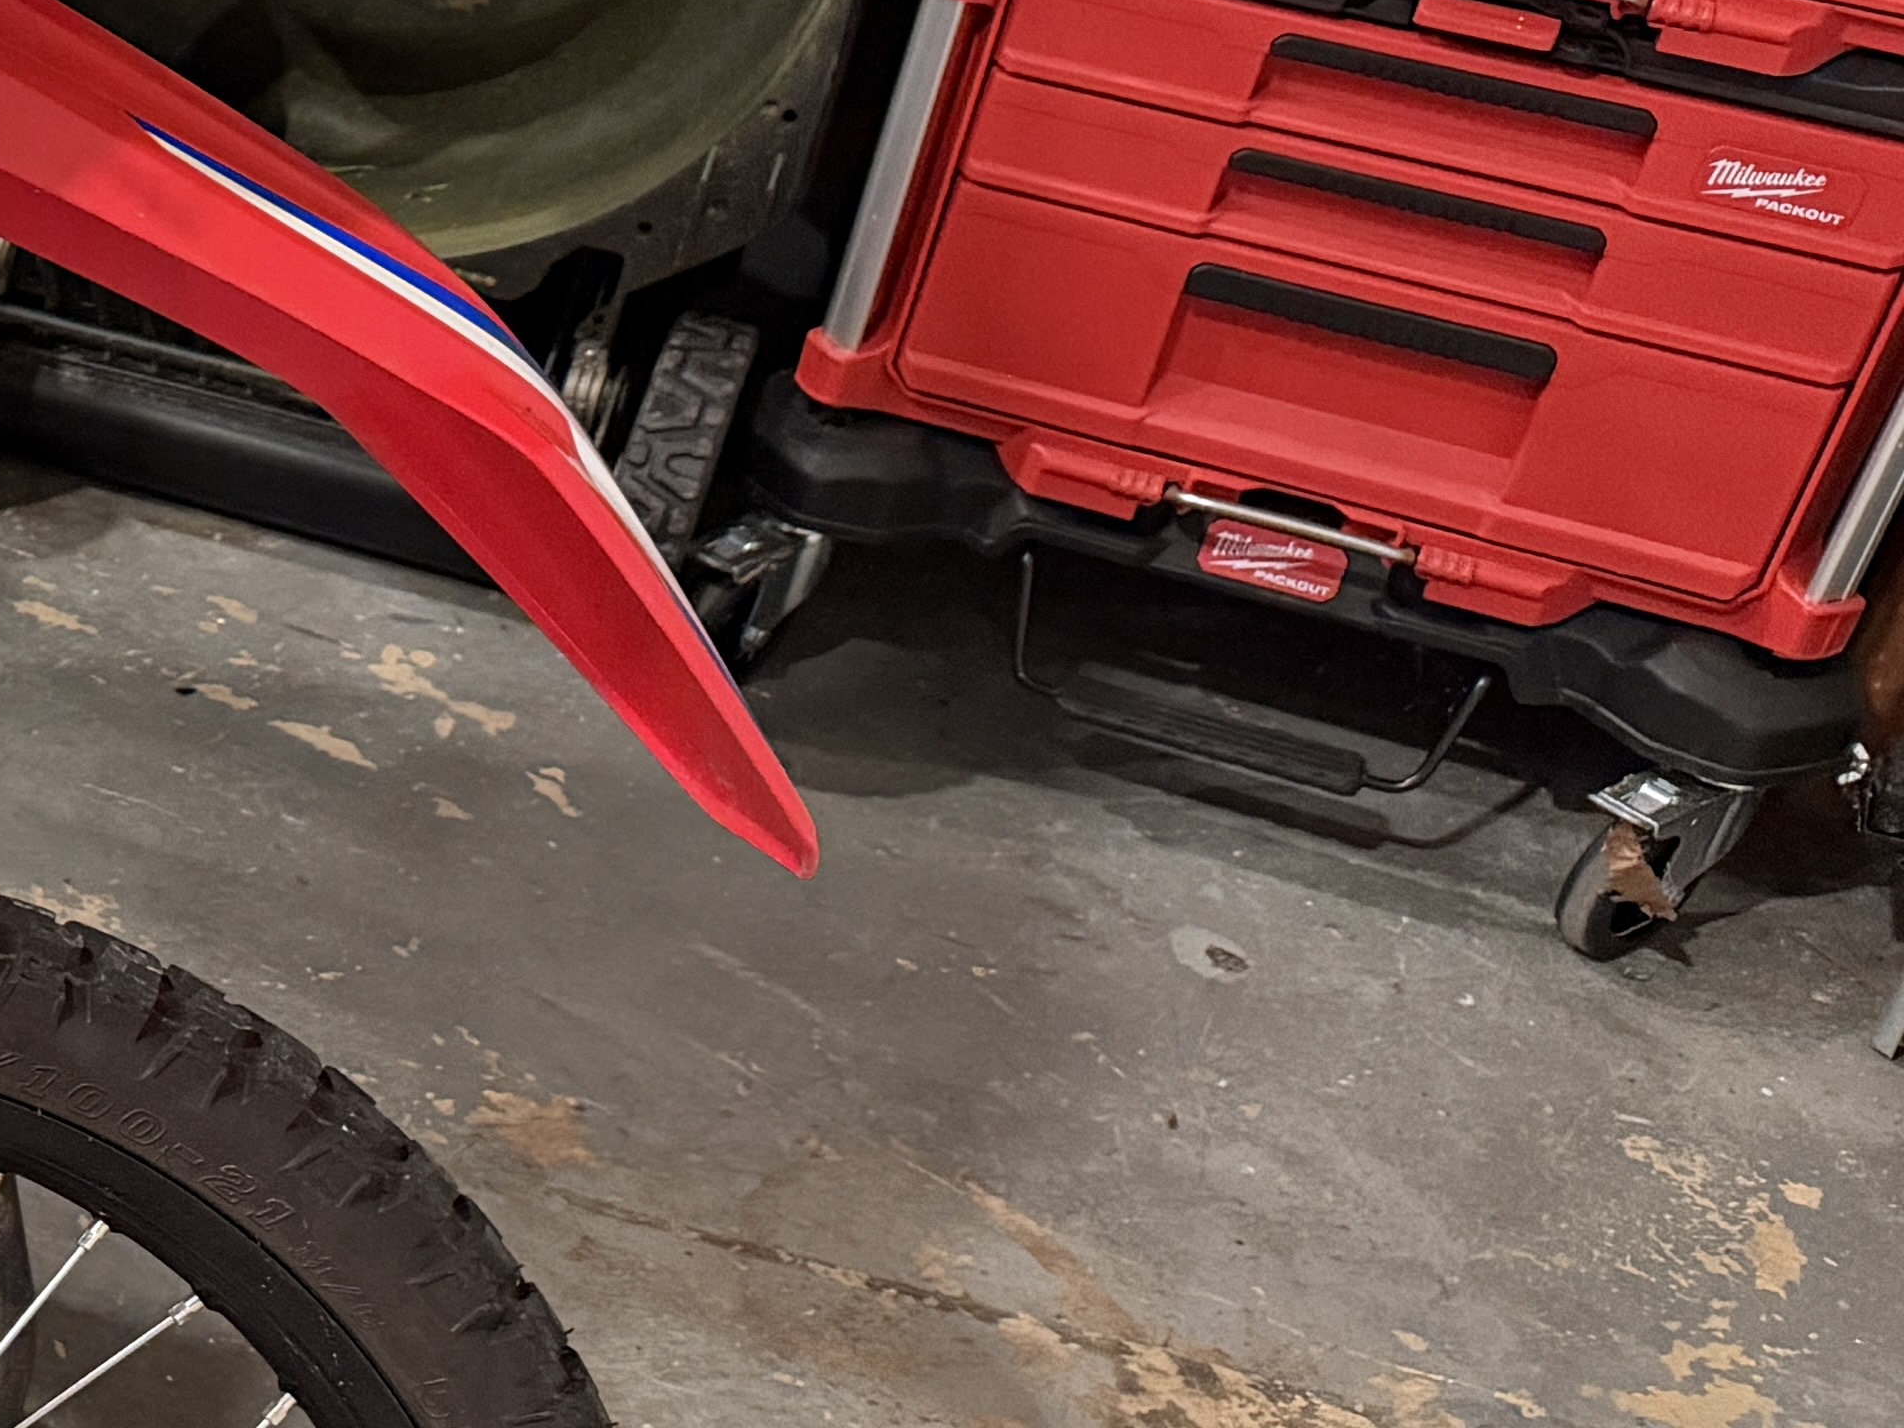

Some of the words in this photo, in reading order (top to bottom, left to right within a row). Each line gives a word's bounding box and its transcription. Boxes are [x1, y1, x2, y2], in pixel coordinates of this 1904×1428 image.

[1707, 158, 1828, 188] Milwaukee
[1753, 196, 1845, 226] PACKOUT
[1213, 530, 1315, 561] Milwaukee
[1252, 568, 1332, 598] PACKOUT
